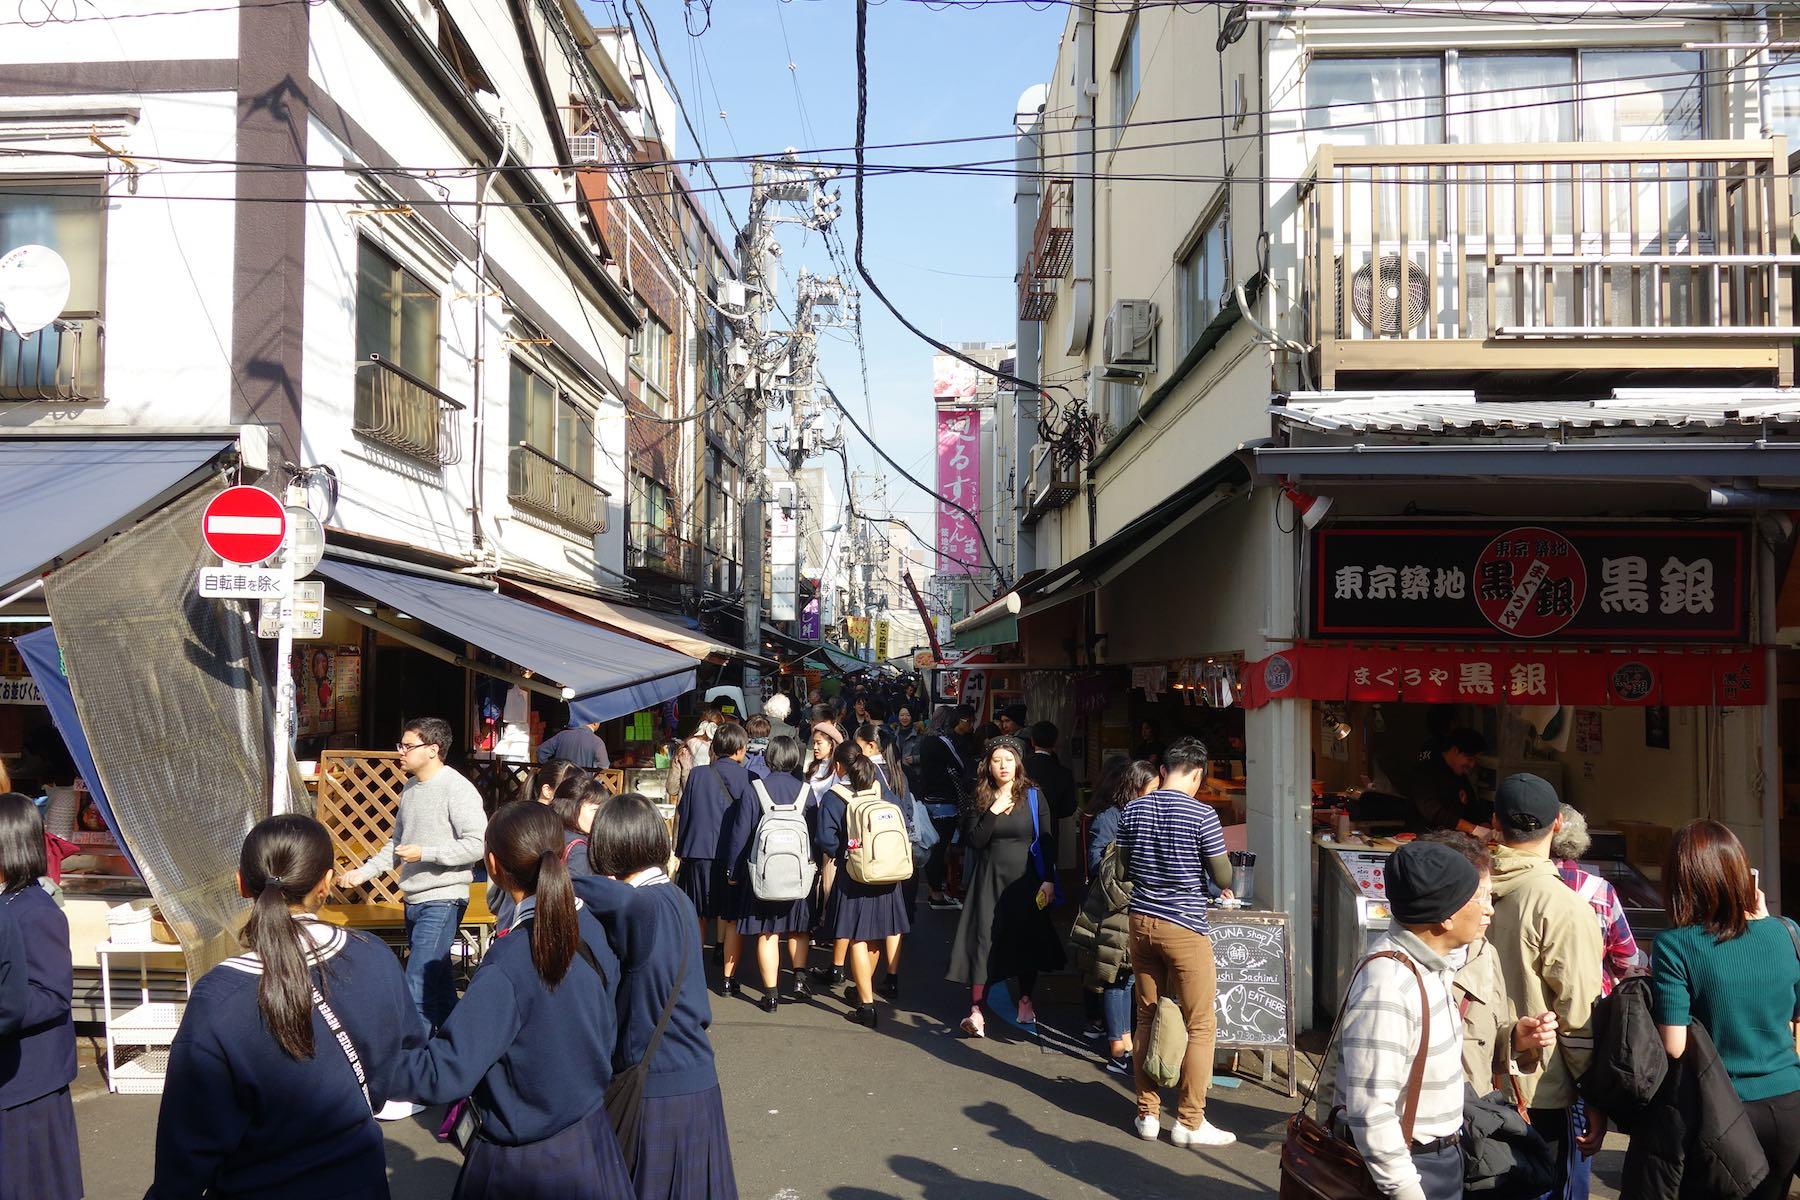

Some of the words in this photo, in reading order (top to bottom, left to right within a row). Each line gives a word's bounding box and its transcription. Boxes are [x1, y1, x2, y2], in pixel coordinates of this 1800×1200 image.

[1496, 541, 1569, 557] 東京築地
[205, 575, 281, 592] 自転車を除く
[1334, 564, 1466, 601] 東京築地
[1600, 555, 1715, 615] 黒銀
[1503, 563, 1545, 627] まぐろや
[1352, 666, 1449, 687] まぐろや
[1458, 662, 1547, 696] 黒銀
[0, 682, 42, 701] お並びくだ
[1210, 927, 1244, 940] TUNA
[1246, 930, 1268, 944] shop
[1229, 945, 1246, 960] 鮪
[1216, 971, 1234, 981] ushi
[1239, 969, 1279, 983] Sashimi
[1248, 990, 1266, 1002] EAT
[1264, 997, 1287, 1014] HERE
[317, 1001, 342, 1031] NEWER
[336, 1030, 359, 1063] ENTRIES
[352, 1059, 366, 1084] OLDER
